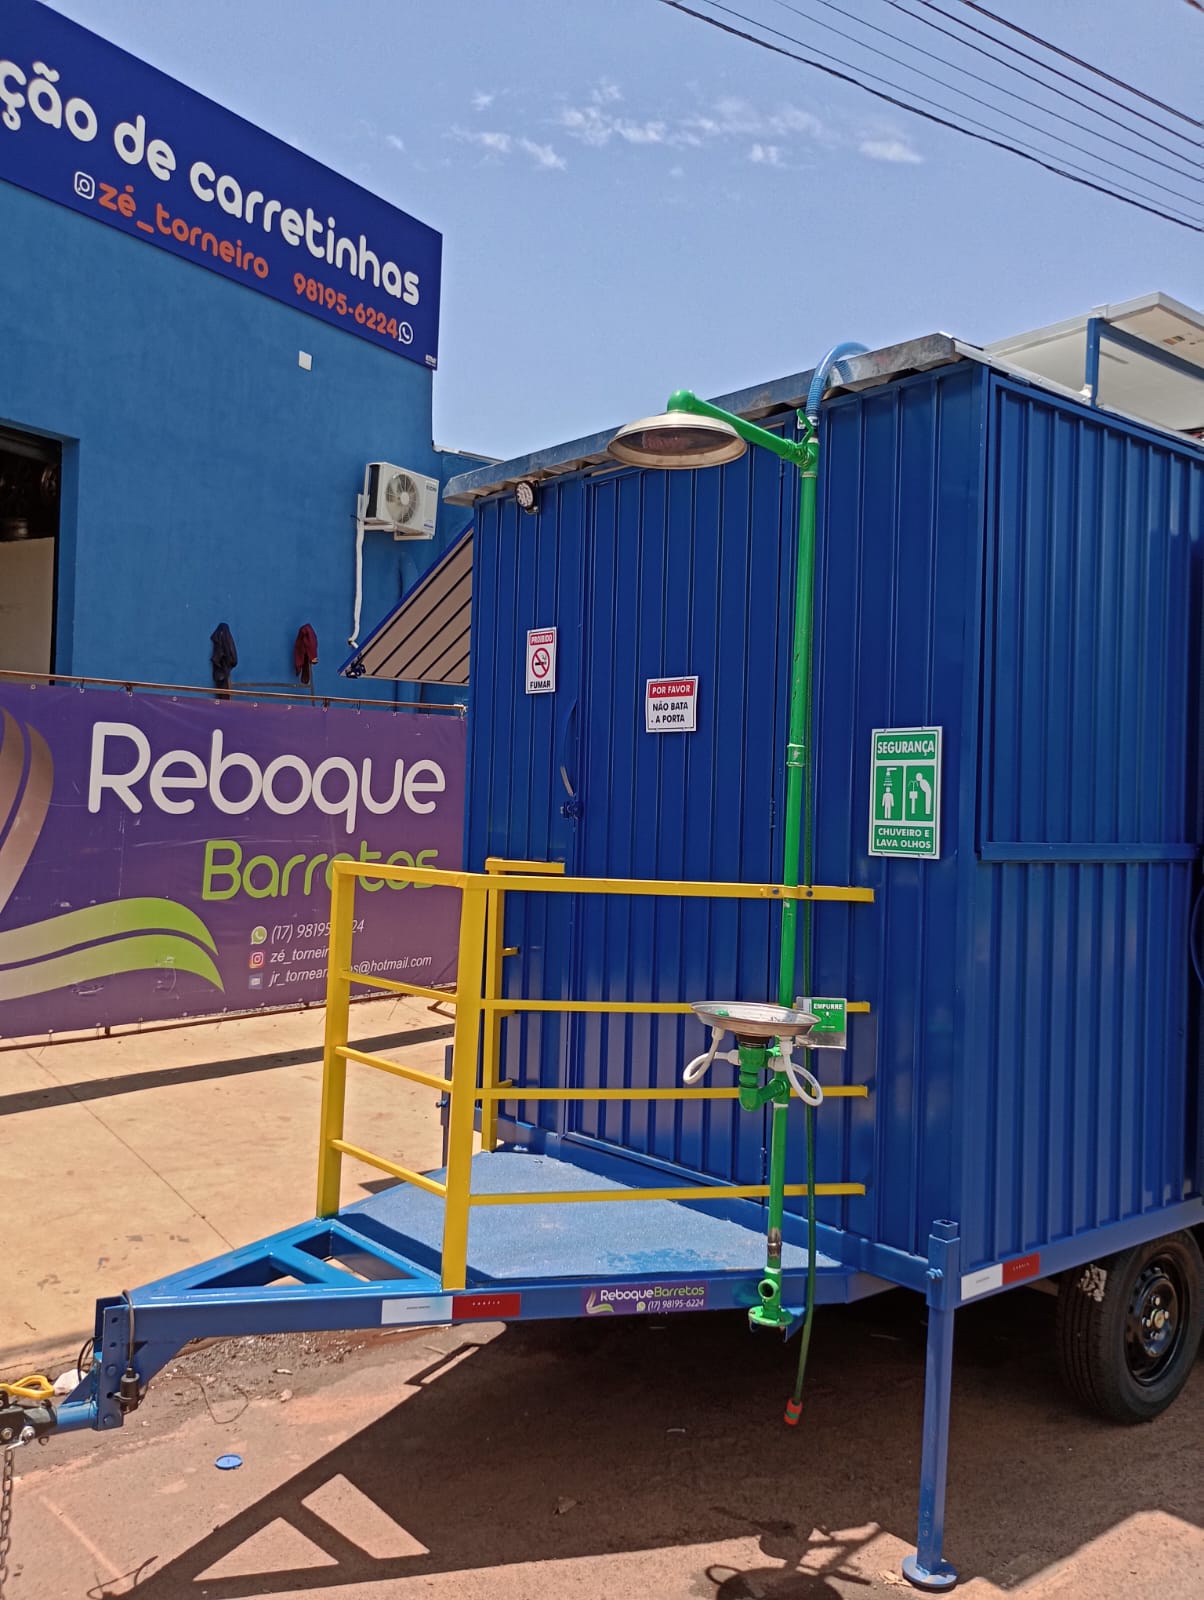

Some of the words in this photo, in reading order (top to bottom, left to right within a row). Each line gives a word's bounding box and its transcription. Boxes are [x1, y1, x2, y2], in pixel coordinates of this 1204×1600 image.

[0, 61, 98, 142] ção
[114, 115, 176, 181] de
[190, 161, 420, 306] carretinhas
[99, 183, 269, 279] zé_torneiro
[293, 272, 399, 339] 98195-6224
[530, 680, 551, 689] FUMAR
[652, 686, 666, 695] POR
[668, 684, 691, 693] FAVOR
[652, 700, 669, 711] NÃO
[671, 702, 688, 711] BATA
[656, 715, 661, 723] A
[663, 714, 685, 723] PORTA
[877, 740, 935, 757] SEGURANÇA
[88, 721, 446, 834] Reboque
[878, 828, 921, 838] CHUVEIRO
[924, 829, 930, 838] E
[876, 838, 898, 847] LAVA
[900, 839, 931, 849] OLHOS
[271, 924, 294, 944] (17)
[270, 945, 330, 965] zé_torneir
[648, 1300, 661, 1312] (17)
[662, 1299, 704, 1309] 98195-6224
